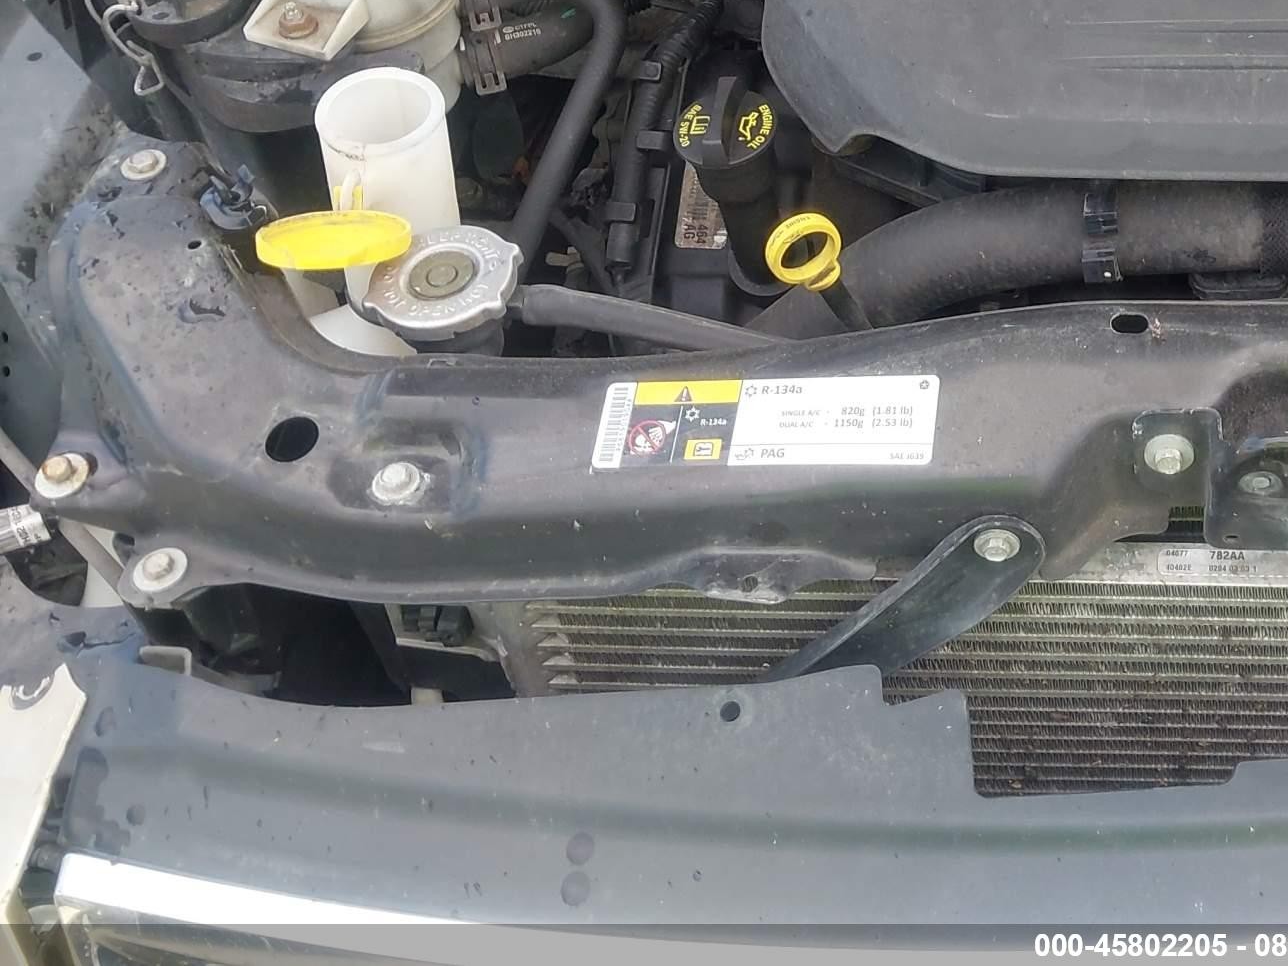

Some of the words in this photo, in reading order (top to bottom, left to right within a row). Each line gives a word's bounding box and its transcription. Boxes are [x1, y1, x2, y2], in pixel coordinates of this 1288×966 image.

[683, 104, 702, 122] SAE
[758, 104, 773, 135] ENGINE
[679, 121, 691, 147] 5W-20
[747, 135, 766, 149] OIL
[408, 304, 456, 316] OPEN
[761, 385, 803, 395] R-134a
[840, 406, 866, 417] 820g
[900, 405, 914, 416] lb)
[700, 418, 727, 426] R-134a
[833, 418, 864, 428] 1150g
[872, 417, 897, 428] (2.53
[900, 417, 914, 428] lb)
[760, 448, 785, 459] PAG
[1209, 551, 1245, 560] 782AA
